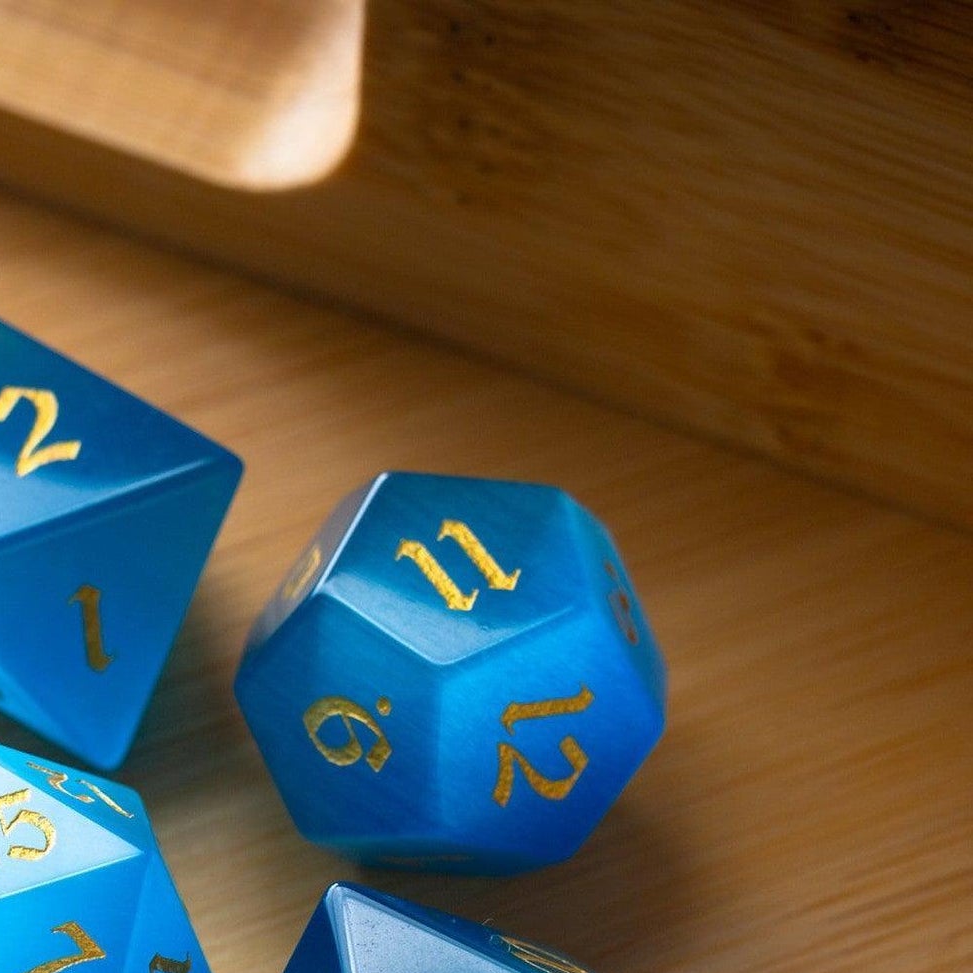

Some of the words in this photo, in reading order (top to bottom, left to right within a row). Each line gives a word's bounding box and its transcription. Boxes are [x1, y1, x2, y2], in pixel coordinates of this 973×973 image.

[395, 519, 521, 611] 11
[68, 583, 114, 673] 1
[492, 682, 595, 807] 12
